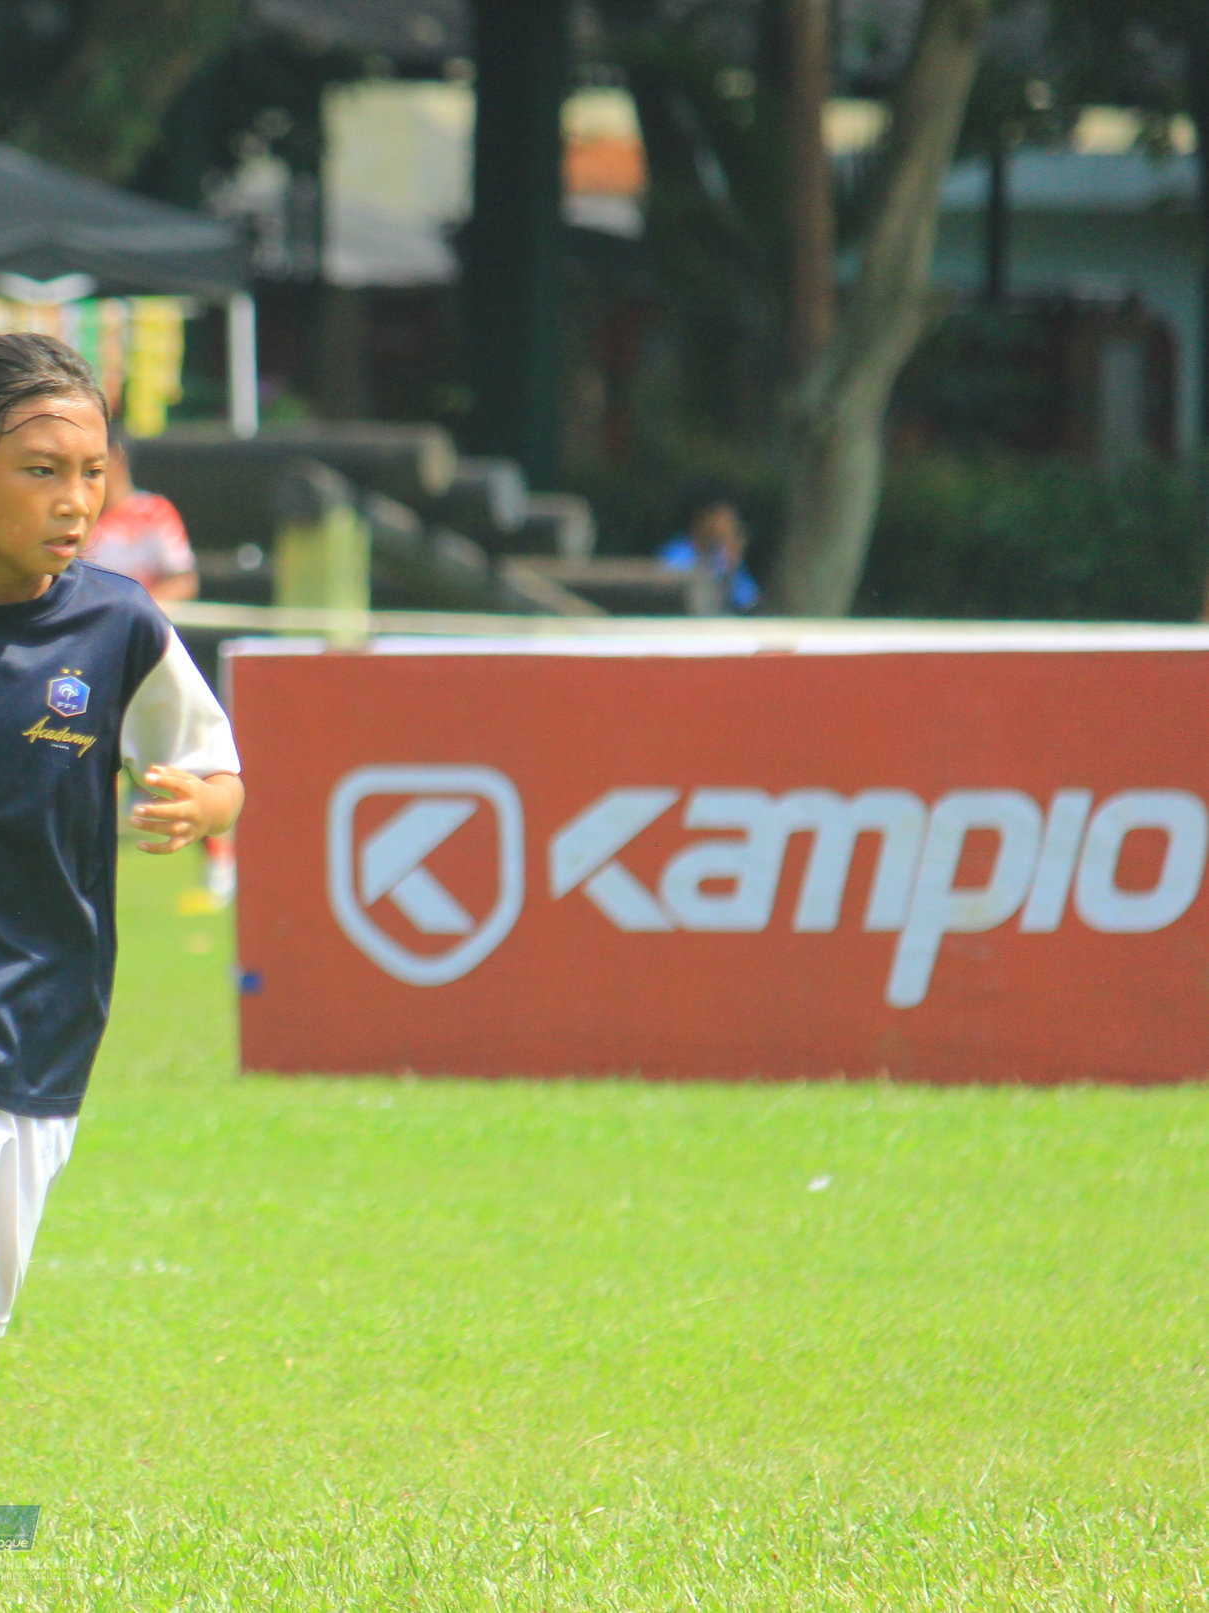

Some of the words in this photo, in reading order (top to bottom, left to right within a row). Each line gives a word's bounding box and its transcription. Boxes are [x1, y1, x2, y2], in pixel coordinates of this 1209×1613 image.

[57, 702, 78, 711] FFF
[22, 715, 98, 758] Academy
[548, 786, 1208, 1009] Kampio
